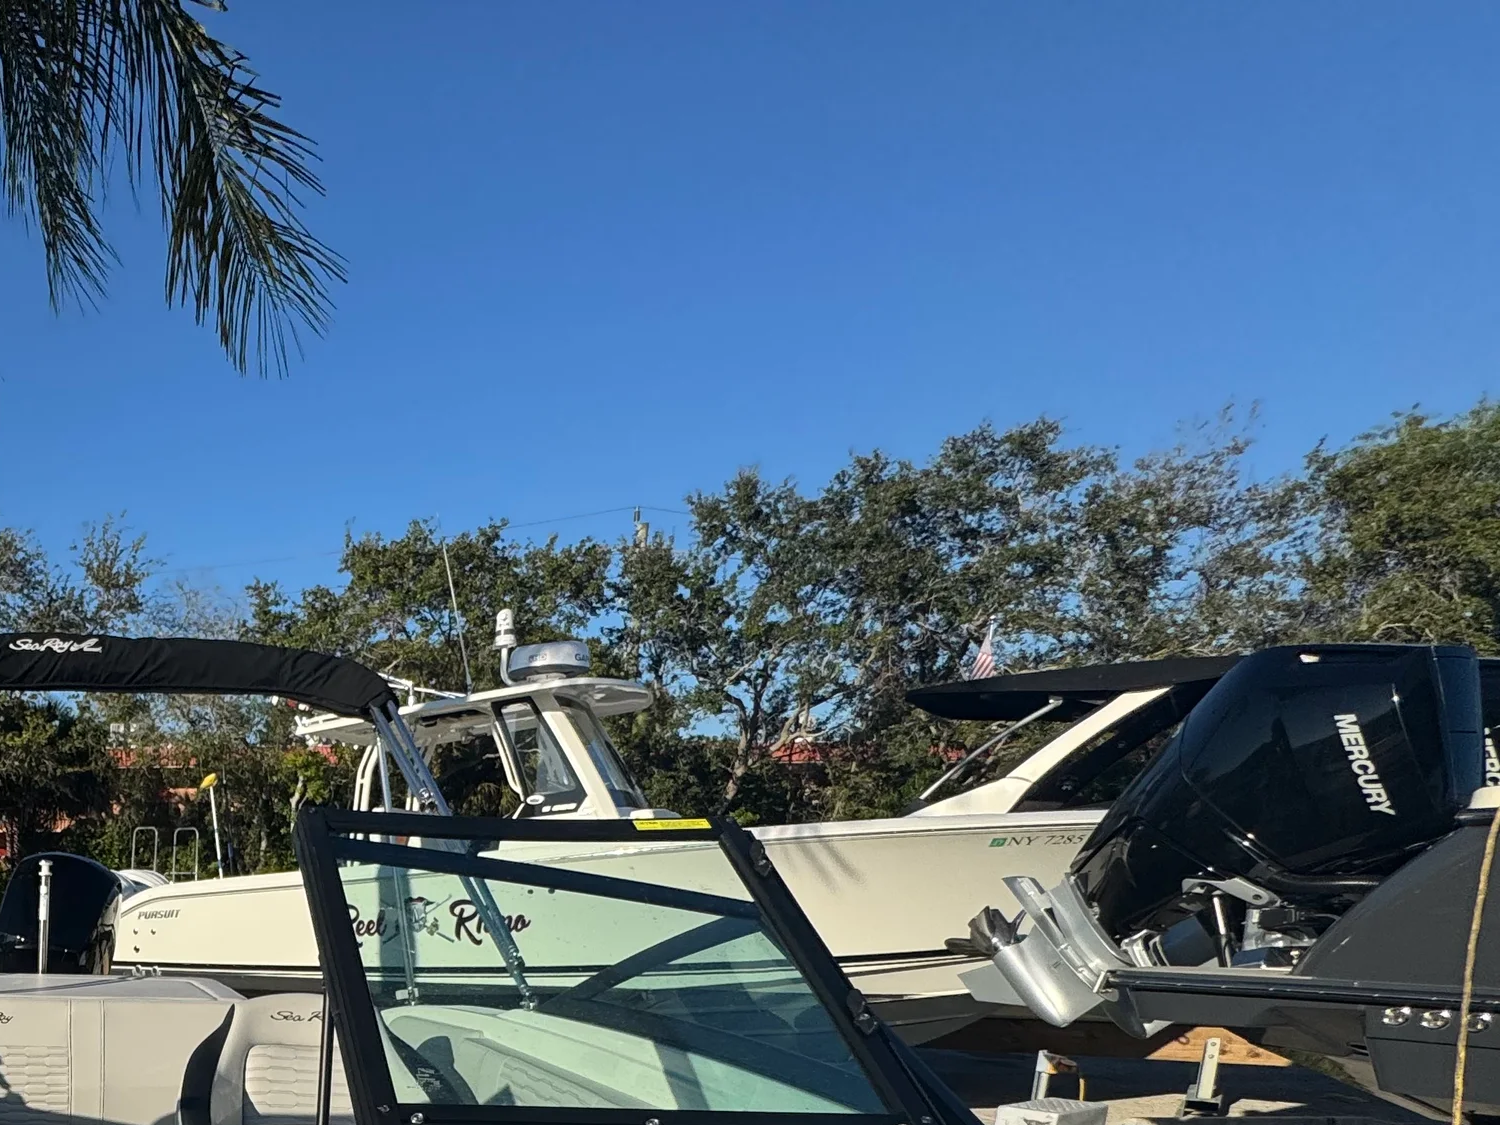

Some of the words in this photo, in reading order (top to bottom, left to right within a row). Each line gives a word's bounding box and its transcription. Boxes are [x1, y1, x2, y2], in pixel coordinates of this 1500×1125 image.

[1333, 713, 1396, 816] MERCURY
[1006, 836, 1041, 846] NY
[1043, 834, 1087, 845] 7285
[137, 908, 181, 920] PURSUIT
[269, 1010, 306, 1022] Sea
